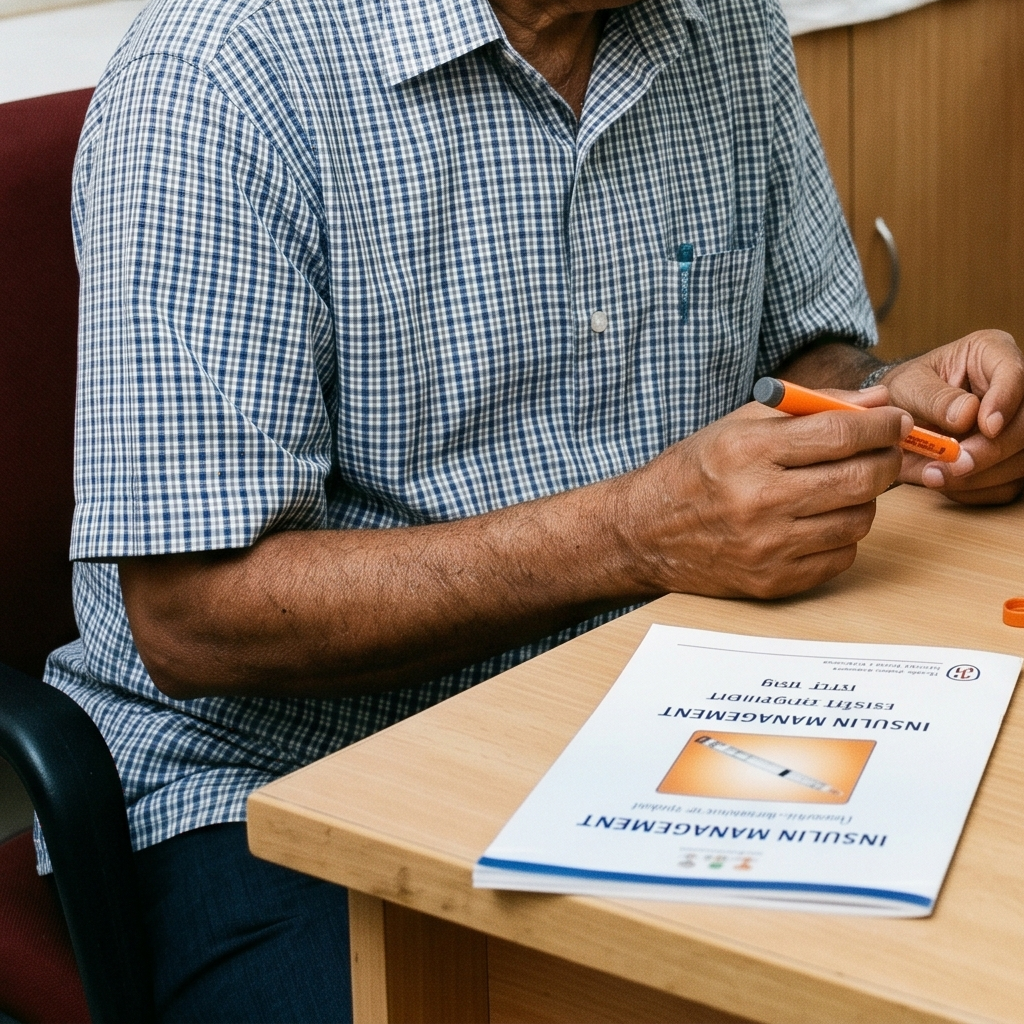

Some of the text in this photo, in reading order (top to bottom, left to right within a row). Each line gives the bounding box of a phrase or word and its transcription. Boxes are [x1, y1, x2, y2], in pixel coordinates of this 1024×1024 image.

[657, 706, 930, 732] INSULIN MANAGEMENT
[576, 813, 771, 841] MANAGEMENT
[778, 829, 888, 847] INSULIN
